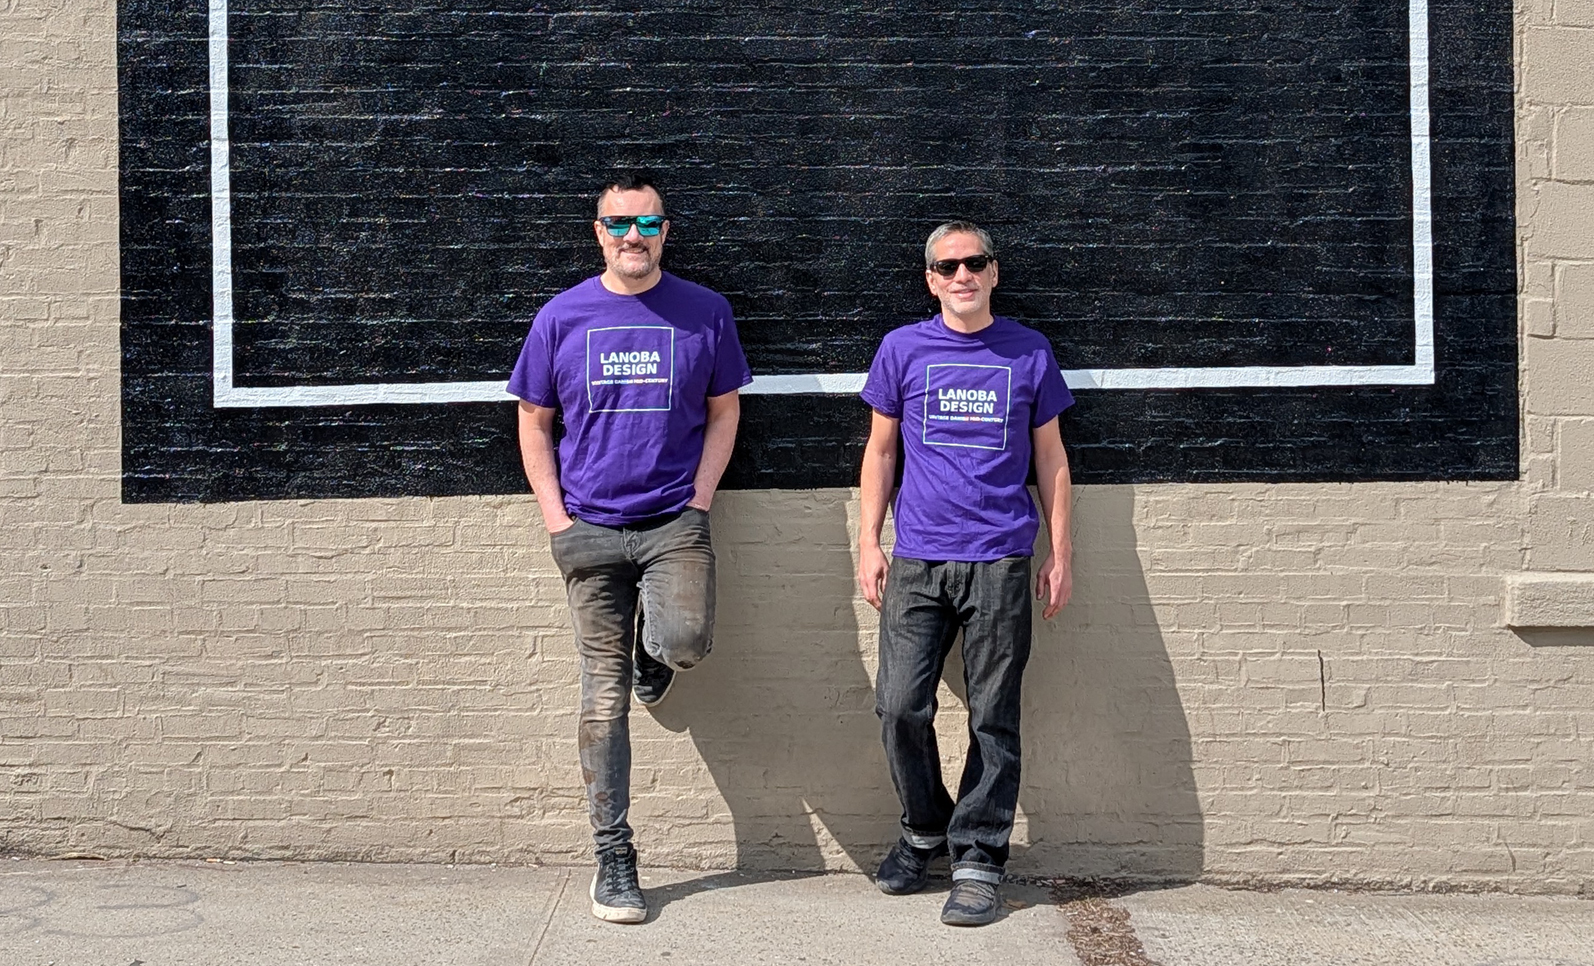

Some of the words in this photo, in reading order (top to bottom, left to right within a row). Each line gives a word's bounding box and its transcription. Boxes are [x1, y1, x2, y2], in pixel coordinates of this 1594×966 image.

[600, 351, 661, 364] LANOBA
[603, 363, 657, 376] DESIGN
[938, 388, 998, 402] LANOBA
[940, 400, 994, 414] DESIGN
